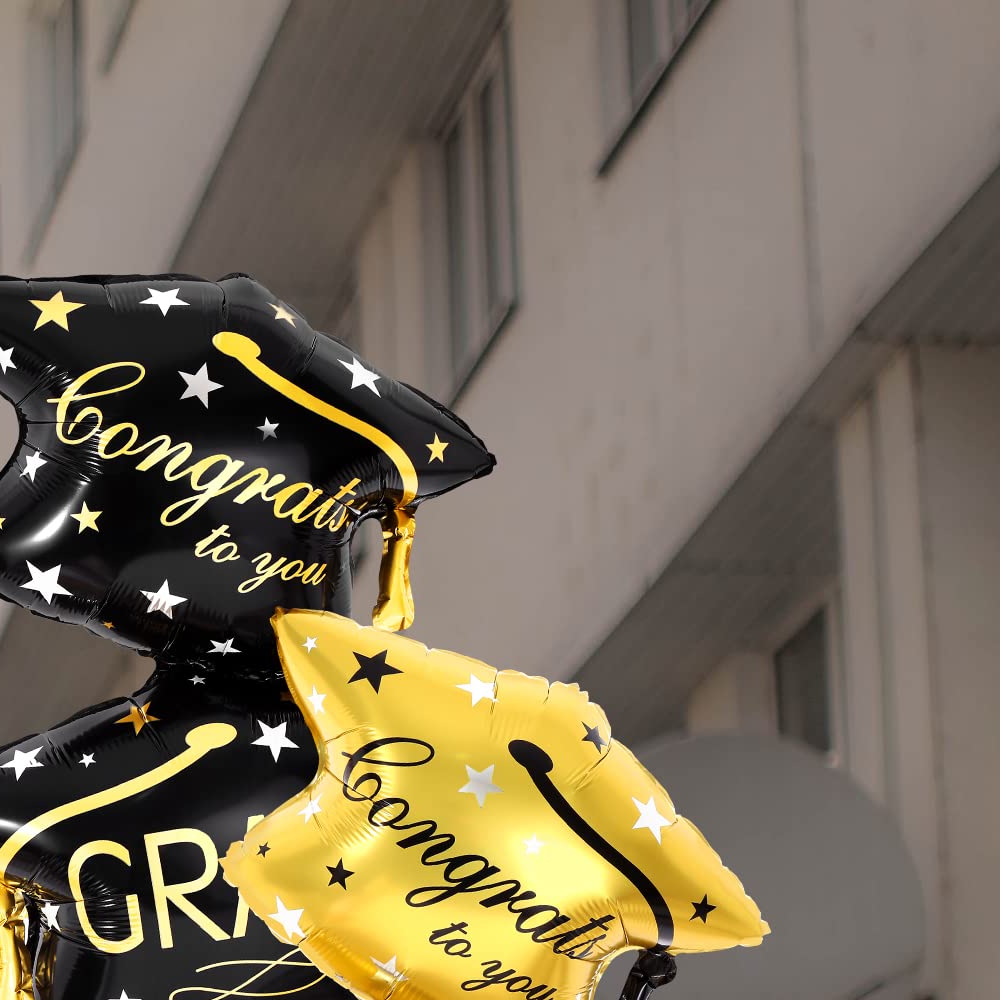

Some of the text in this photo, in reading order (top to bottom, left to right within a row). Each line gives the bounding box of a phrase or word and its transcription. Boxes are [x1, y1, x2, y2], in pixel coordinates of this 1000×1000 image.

[46, 361, 361, 532] Congrats
[194, 524, 327, 594] to you
[341, 736, 616, 961] Congrats
[428, 921, 472, 958] to
